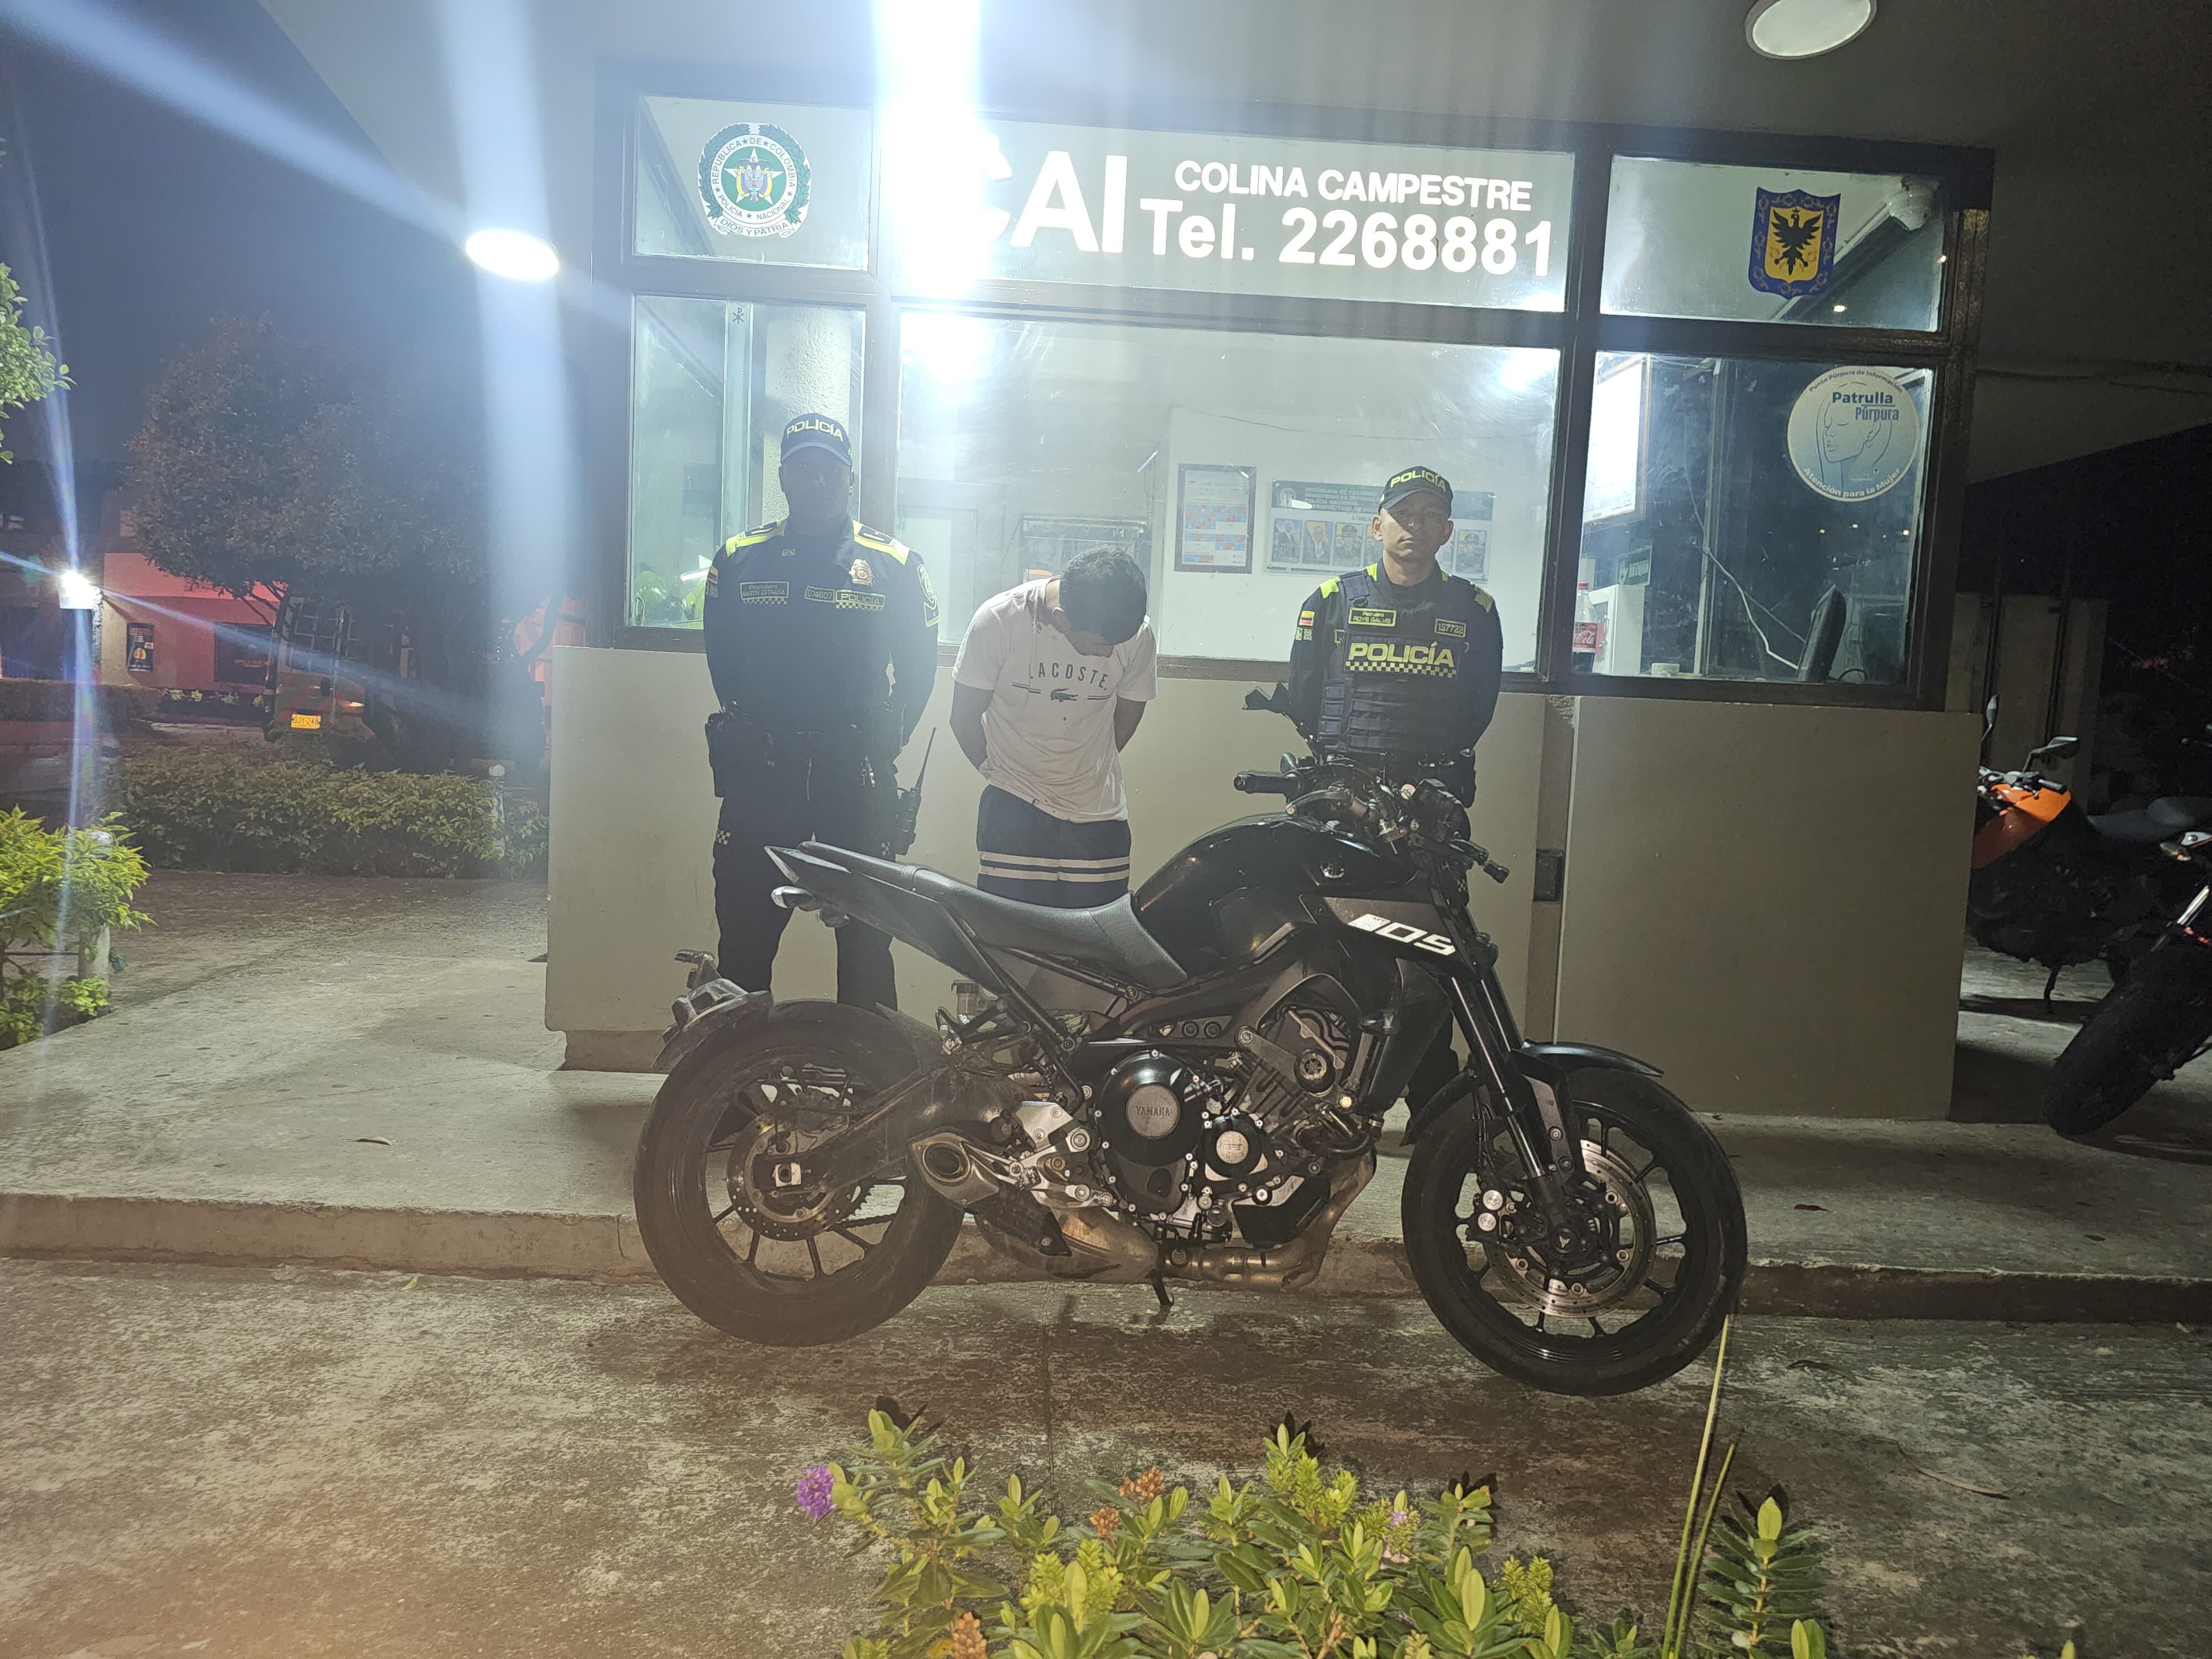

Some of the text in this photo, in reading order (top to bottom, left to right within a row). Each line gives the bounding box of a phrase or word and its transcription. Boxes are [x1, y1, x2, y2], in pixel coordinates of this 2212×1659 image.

[712, 140, 742, 184] REPUBLICA
[770, 143, 795, 187] COLOMBIA
[1175, 160, 1532, 212] COLINA CAMPESTRE
[718, 195, 790, 220] POLICIA NACIONAL
[720, 219, 744, 233] DIOS
[754, 222, 789, 236] PATRIA
[1140, 198, 1551, 276] Tel. 2268881
[1832, 392, 1893, 404] Patrulla
[1855, 405, 1900, 422] Púrpura
[1876, 467, 1901, 491] Mujer
[1438, 622, 1464, 634] 157722
[1348, 640, 1455, 668] POLICÍA
[1030, 662, 1108, 688] ACOSTE
[1136, 1105, 1171, 1117] YAMAHA
